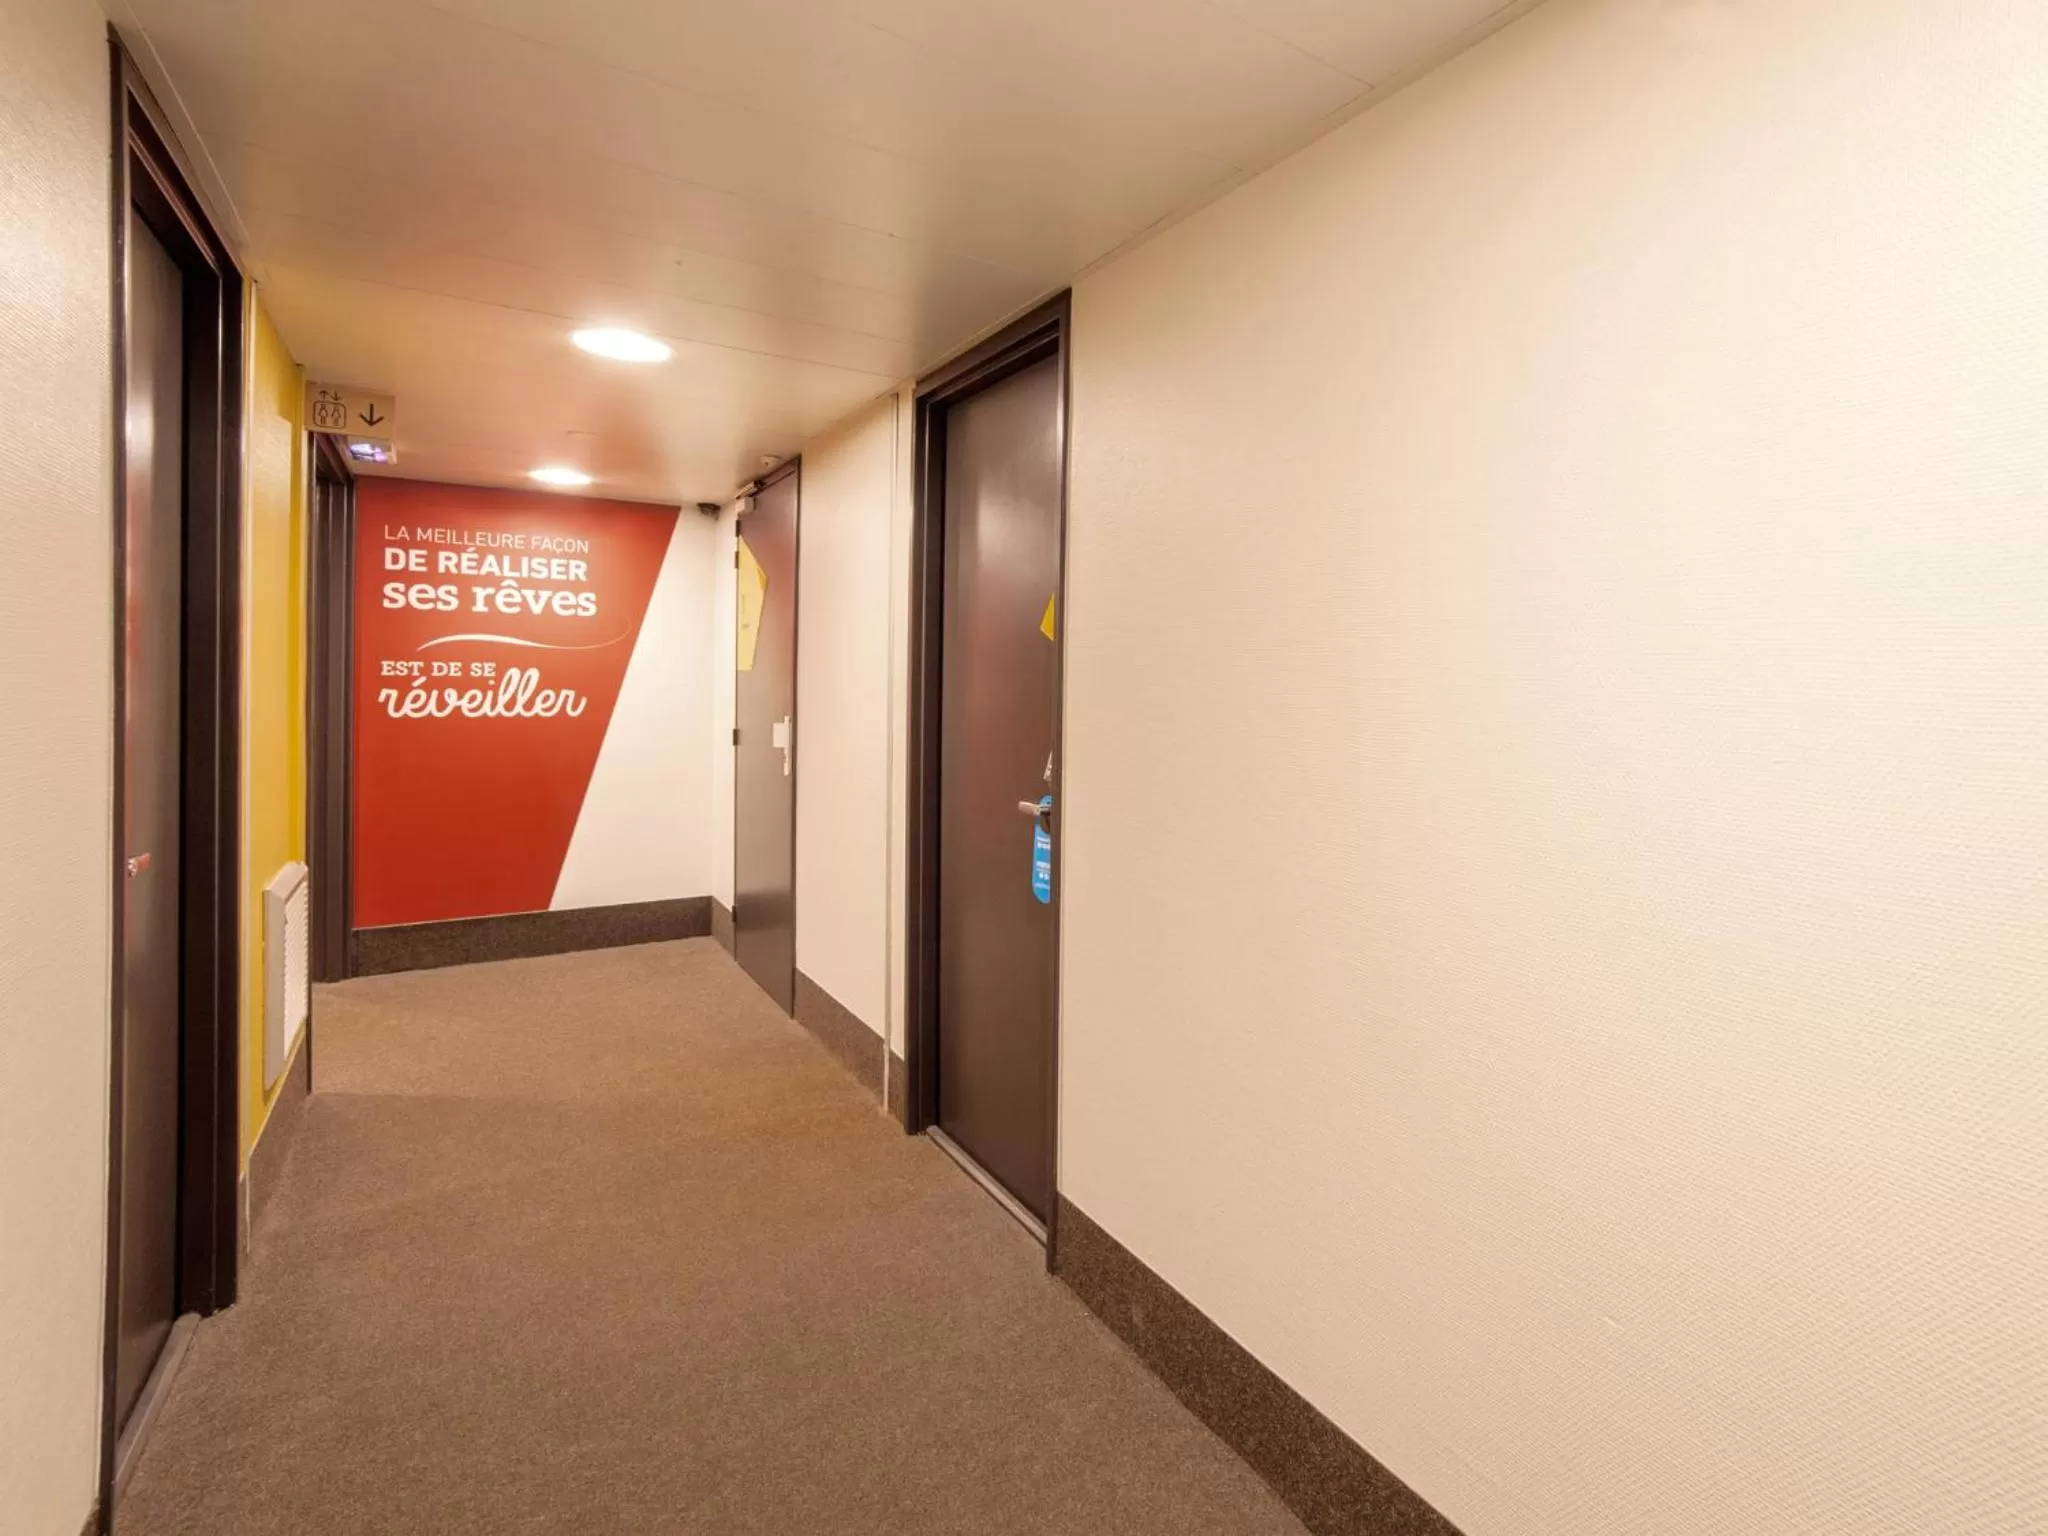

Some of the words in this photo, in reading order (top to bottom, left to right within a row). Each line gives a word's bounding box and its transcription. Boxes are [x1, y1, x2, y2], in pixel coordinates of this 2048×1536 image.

[384, 524, 410, 541] LA
[416, 527, 525, 549] MEILLEURE
[531, 535, 589, 554] FAÇON
[384, 547, 428, 572] DE
[437, 547, 588, 581] RÉALISER
[383, 582, 459, 611] ses
[471, 579, 597, 616] rêves
[380, 661, 424, 676] EST
[431, 661, 462, 677] DE
[469, 661, 496, 677] SE
[378, 667, 588, 718] réveiller
